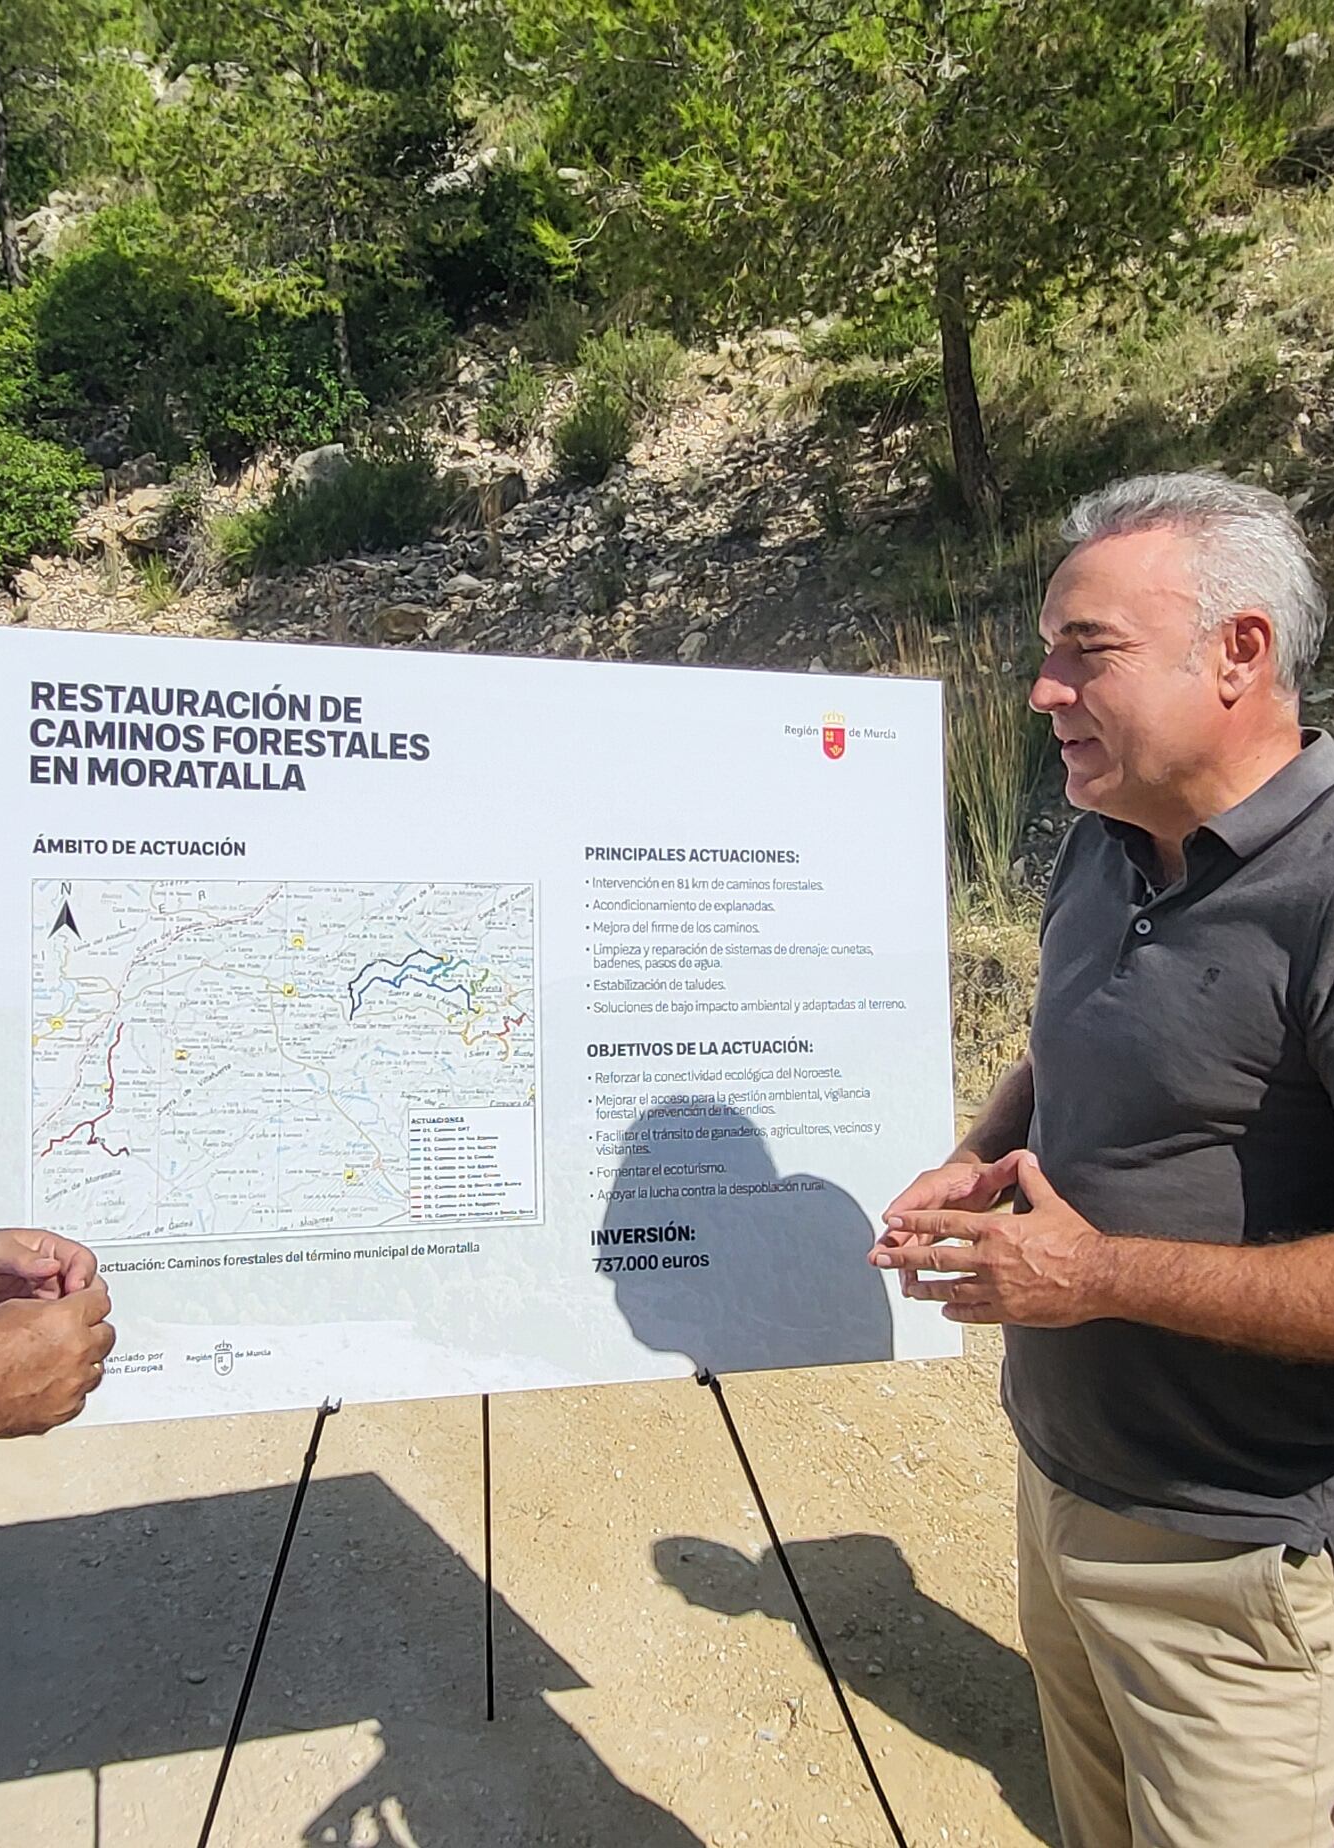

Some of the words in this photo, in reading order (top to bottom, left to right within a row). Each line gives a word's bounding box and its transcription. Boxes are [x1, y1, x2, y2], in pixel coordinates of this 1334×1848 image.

[30, 681, 311, 722] RESTAURACIÓN
[319, 696, 362, 724] DE
[29, 718, 205, 753] CAMINOS
[214, 725, 430, 761] FORESTALES
[785, 725, 819, 737] Región
[848, 728, 861, 738] de
[864, 728, 897, 739] Murcia
[30, 755, 78, 784] EN
[87, 757, 306, 791] MORATALLA
[33, 834, 108, 855] ÁMBITO
[112, 840, 136, 855] DE
[140, 837, 246, 856] ACTUACIÓN
[585, 847, 686, 862] PRINCIPALES
[689, 849, 800, 863] ACTUACIONES:
[60, 882, 72, 895] N
[593, 877, 659, 889] Intervención
[661, 880, 675, 888] en
[677, 878, 690, 889] 81
[692, 878, 708, 889] km
[711, 879, 724, 889] de
[726, 879, 770, 890] caminos
[772, 879, 824, 891] forestales.
[593, 900, 696, 912] Acondicionamiento
[698, 901, 712, 912] de
[714, 901, 775, 914] explanadas.
[593, 922, 630, 935] Mejora
[632, 922, 648, 933] del
[651, 922, 679, 933] firme
[680, 922, 694, 933] de
[696, 922, 711, 933] los
[713, 923, 759, 933] caminos.
[593, 944, 641, 960] Limpieza
[643, 946, 649, 958] y
[652, 943, 707, 957] reparación
[710, 944, 723, 955] de
[725, 944, 772, 955] sistemas
[774, 944, 787, 955] de
[789, 944, 829, 957] drenaje:
[831, 944, 873, 956] cunetas,
[593, 957, 642, 970] badenes,
[645, 959, 676, 971] pasos
[679, 957, 692, 968] de
[694, 959, 722, 971] agua.
[593, 979, 667, 991] Estabilización
[669, 980, 682, 990] de
[685, 979, 726, 990] taludes.
[594, 1002, 652, 1013] Soluciones
[656, 1002, 669, 1012] de
[671, 1001, 694, 1014] bajo
[695, 1001, 738, 1014] impacto
[741, 1000, 792, 1012] ambiental
[794, 1002, 800, 1013] y
[802, 1000, 856, 1012] adaptadas
[858, 999, 866, 1010] al
[868, 1000, 906, 1010] terreno.
[587, 1042, 673, 1057] OBJETIVOS
[676, 1042, 695, 1056] DE
[699, 1042, 718, 1055] LA
[721, 1037, 813, 1055] ACTUACIÓN:
[595, 1072, 640, 1084] Reforzar
[643, 1071, 652, 1082] la
[654, 1070, 722, 1082] conectividad
[724, 1069, 774, 1084] ecológica
[776, 1068, 791, 1080] del
[793, 1067, 842, 1079] Noroeste.
[596, 1094, 636, 1107] Mejorar
[639, 1094, 649, 1105] el
[651, 1095, 689, 1105] acceso
[691, 1094, 714, 1106] para
[717, 1092, 726, 1103] la
[728, 1090, 766, 1105] gestión
[768, 1089, 822, 1102] ambiental,
[824, 1088, 870, 1101] vigilancia
[596, 1108, 637, 1120] forestal
[639, 1111, 645, 1121] y
[647, 1105, 706, 1120] prevención
[708, 1106, 721, 1117] de
[723, 1105, 776, 1116] incendios.
[596, 1129, 639, 1142] Facilitar
[641, 1129, 651, 1140] el
[652, 1128, 693, 1140] tránsito
[696, 1128, 709, 1138] de
[711, 1126, 768, 1140] ganaderos,
[770, 1124, 831, 1137] agricultores,
[833, 1123, 871, 1134] vecinos
[873, 1125, 880, 1134] y
[596, 1144, 651, 1156] visitantes.
[597, 1166, 650, 1177] Fomentar
[652, 1164, 662, 1175] el
[663, 1162, 726, 1175] ecoturismo.
[597, 1189, 636, 1202] Apoyar
[638, 1188, 647, 1199] la
[649, 1187, 679, 1198] lucha
[681, 1186, 715, 1197] contra
[718, 1184, 727, 1195] la
[729, 1181, 798, 1195] despoblación
[591, 1221, 696, 1246] INVERSIÓN:
[99, 1258, 165, 1273] actuación:
[167, 1255, 221, 1269] Caminos
[223, 1253, 283, 1266] forestales
[285, 1251, 303, 1262] del
[306, 1249, 350, 1263] término
[353, 1245, 409, 1261] municipal
[411, 1245, 425, 1256] de
[427, 1242, 480, 1255] Moratalla
[592, 1256, 658, 1273] 737.000
[662, 1254, 709, 1269] euros
[148, 1353, 163, 1361] por
[125, 1365, 163, 1373] Europea
